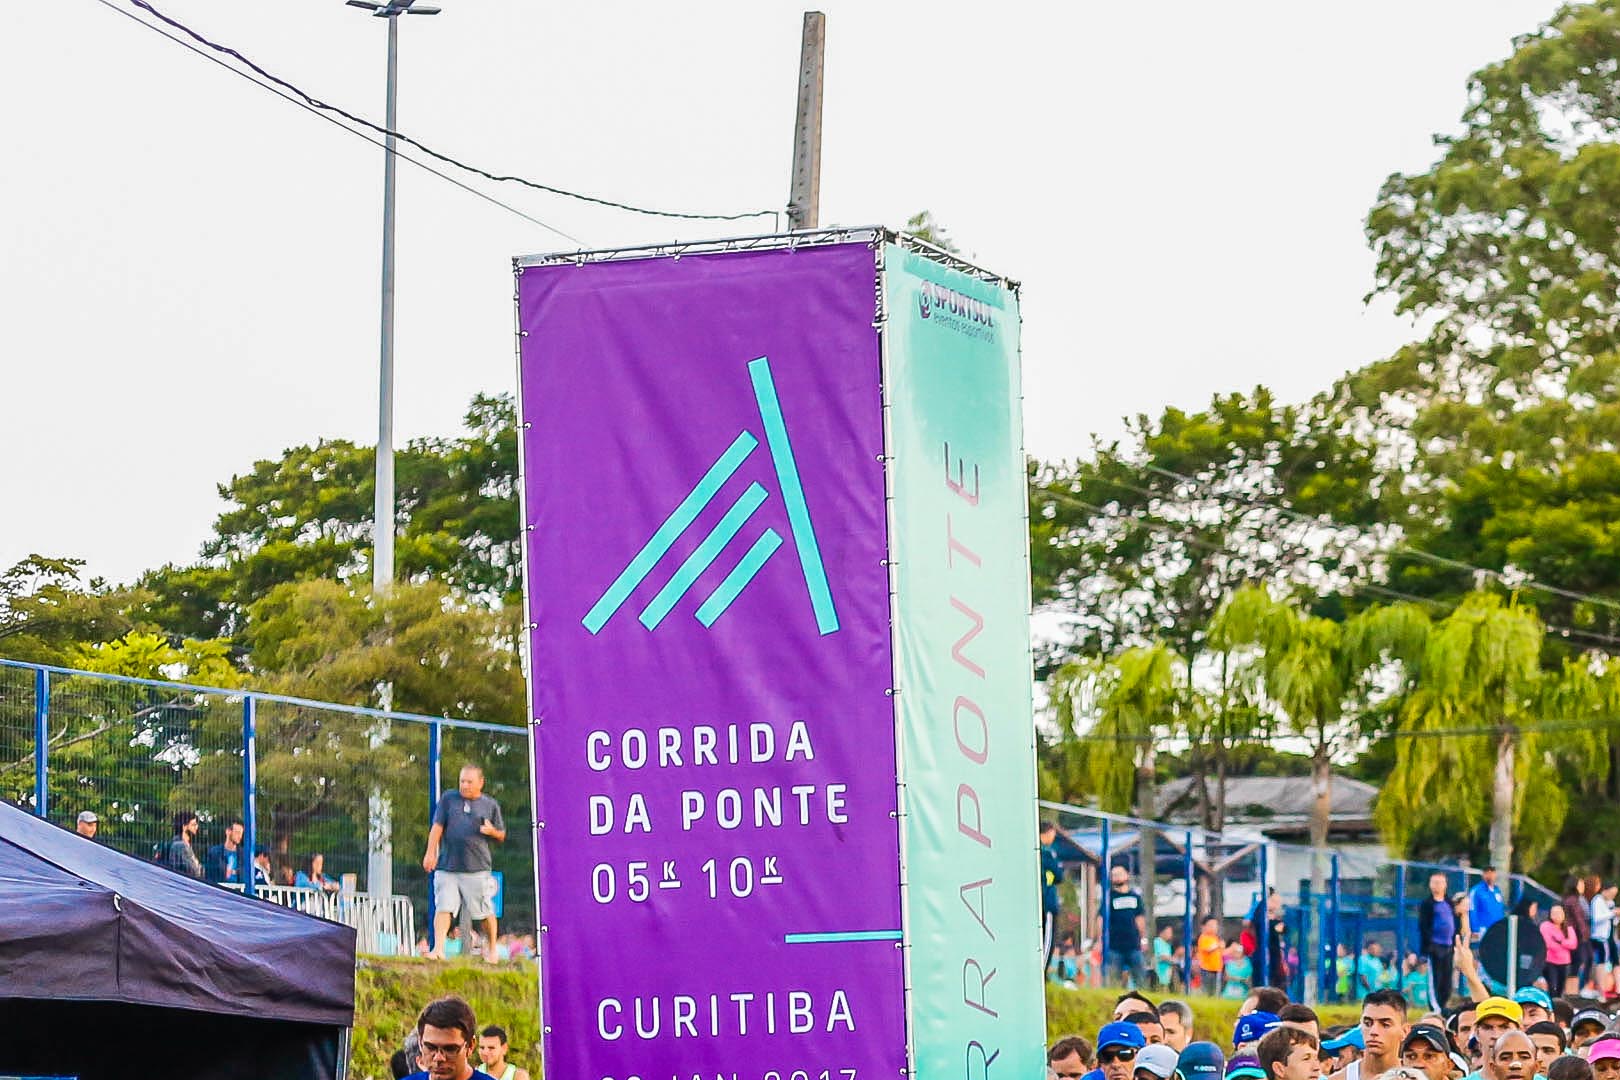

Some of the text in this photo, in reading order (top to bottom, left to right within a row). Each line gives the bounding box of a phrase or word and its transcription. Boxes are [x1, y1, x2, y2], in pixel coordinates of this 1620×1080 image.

[586, 720, 815, 772] CORRIDA
[588, 783, 849, 836] DA PONTE
[597, 989, 856, 1041] CURITIBA
